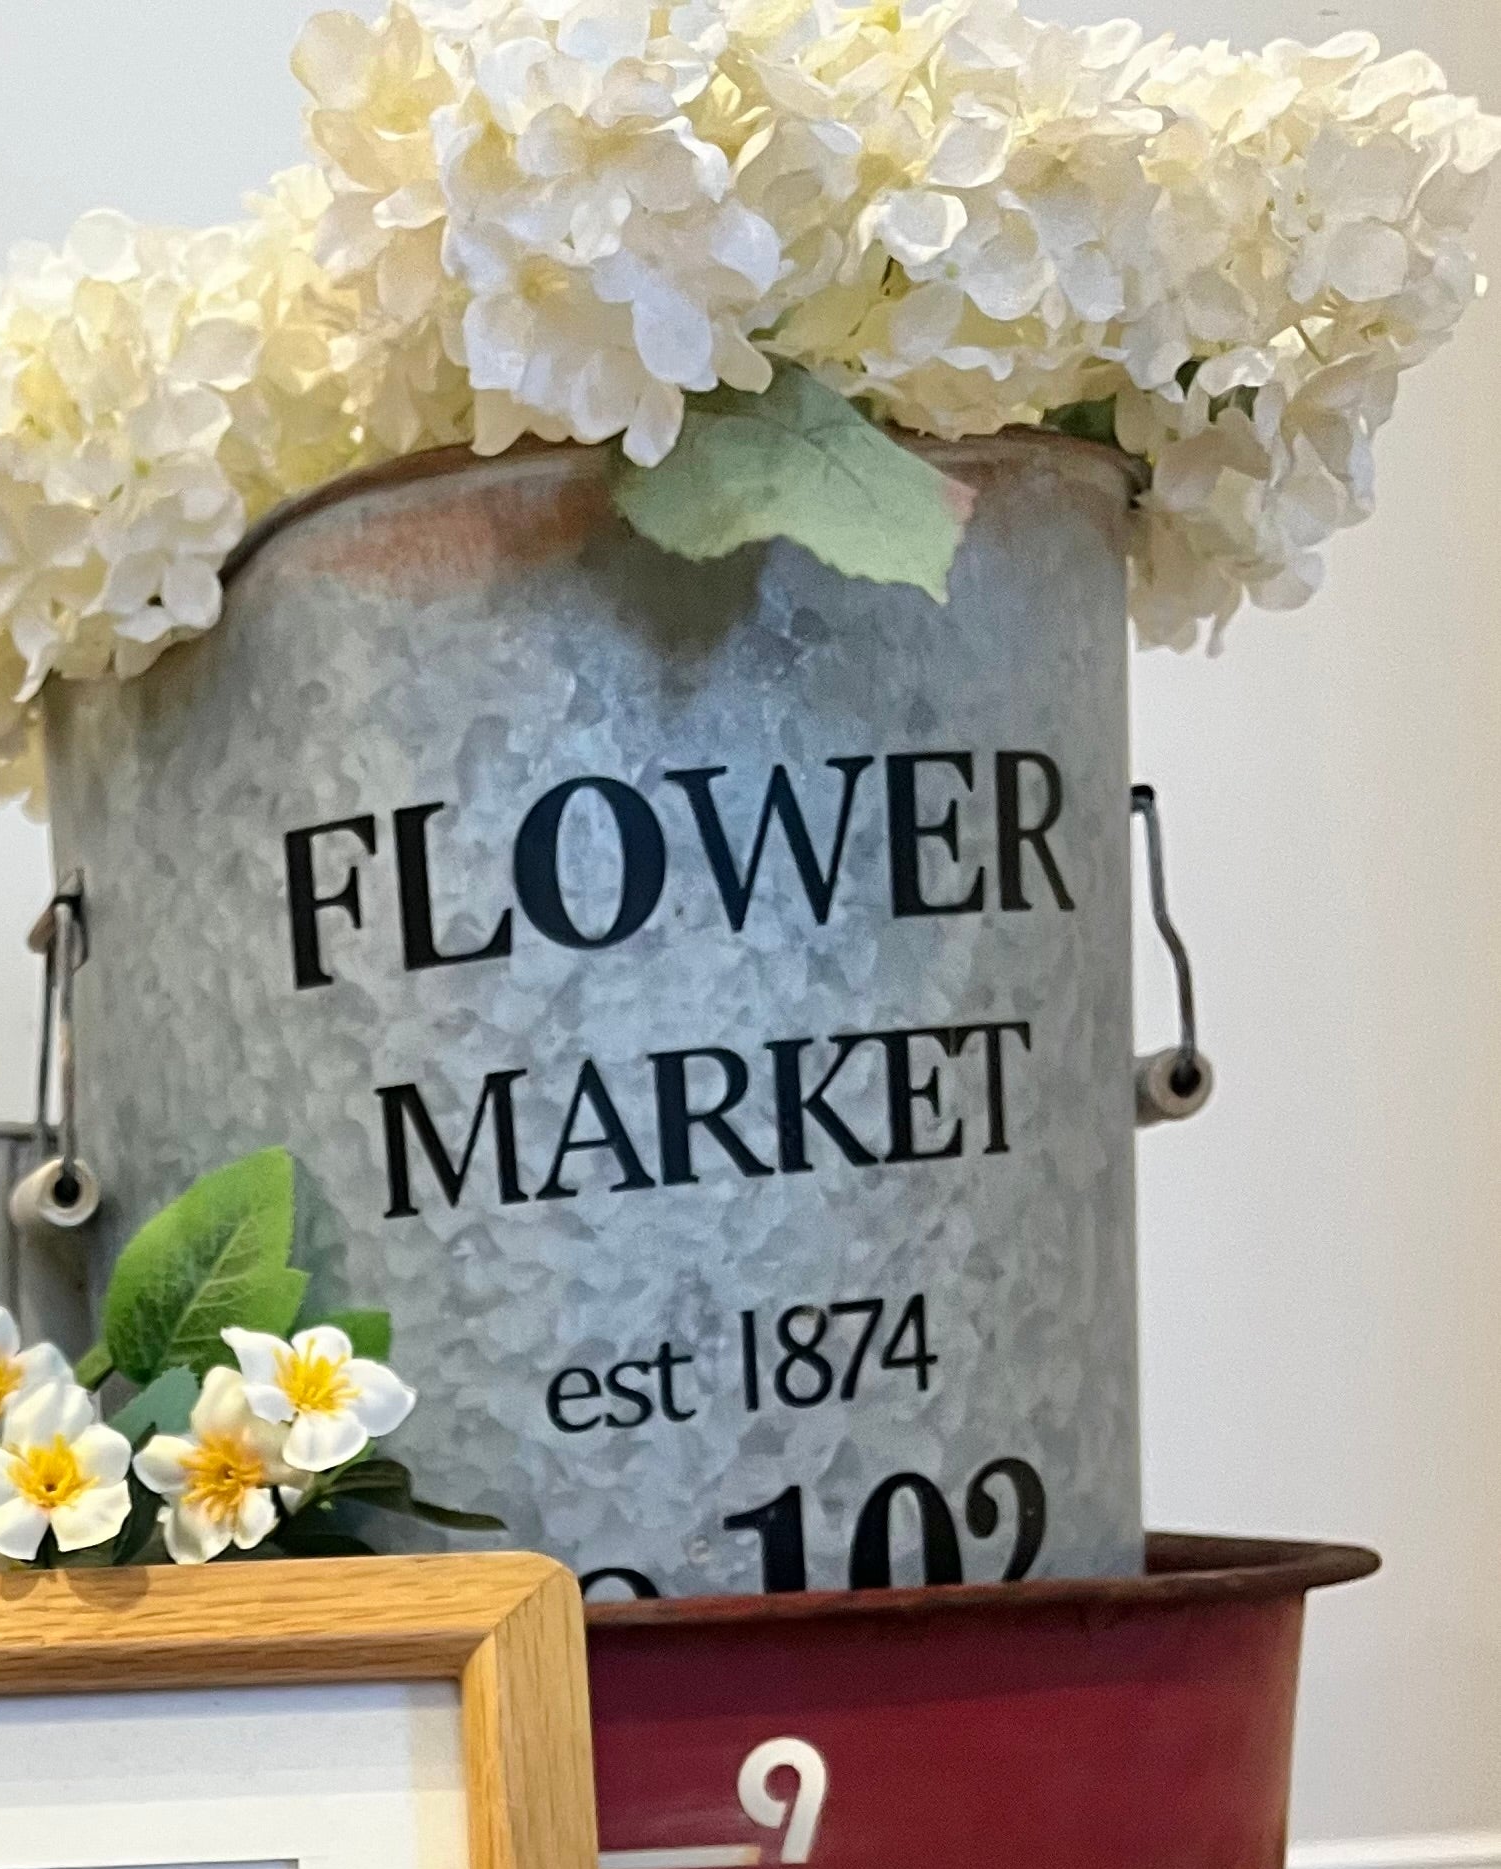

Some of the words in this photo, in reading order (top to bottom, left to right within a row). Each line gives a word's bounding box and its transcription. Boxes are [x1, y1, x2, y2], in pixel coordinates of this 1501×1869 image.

[283, 750, 1075, 991] FLOWER
[375, 1020, 1031, 1219] MARKET
[545, 1342, 697, 1434] est
[741, 1293, 938, 1412] 1874
